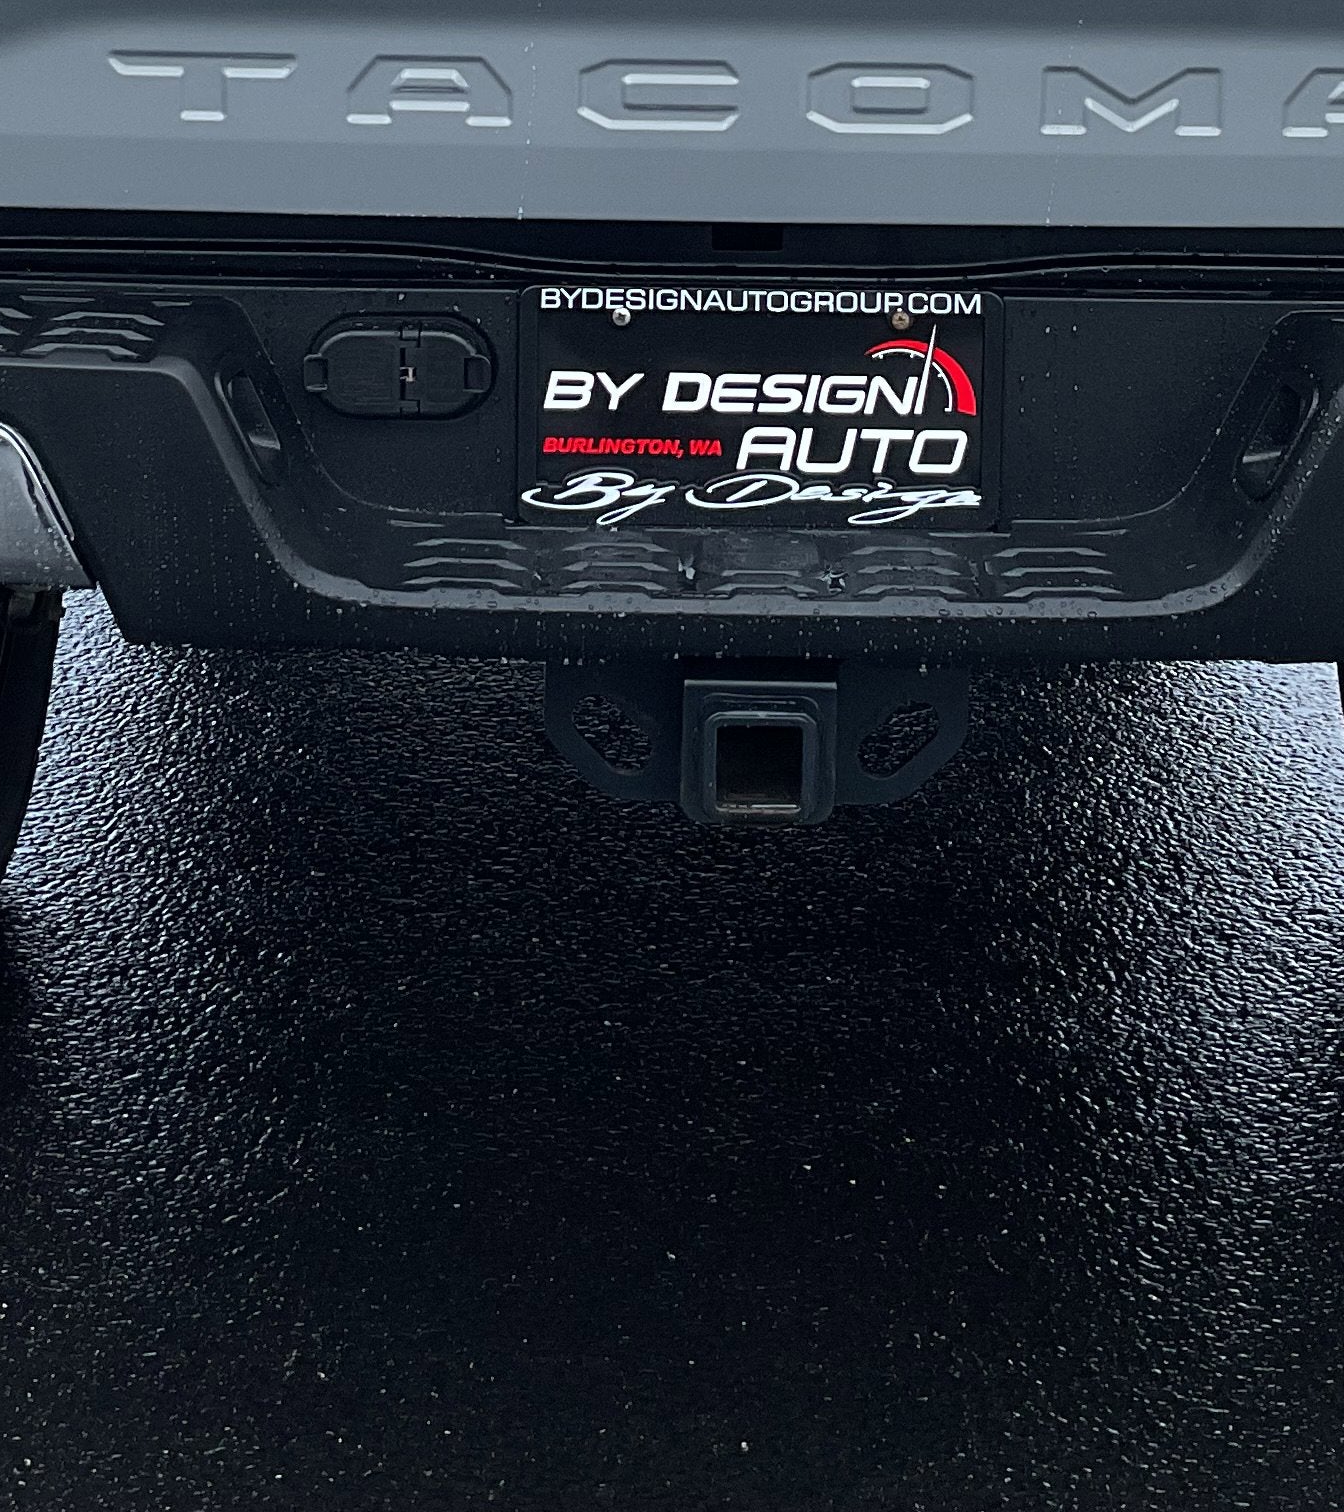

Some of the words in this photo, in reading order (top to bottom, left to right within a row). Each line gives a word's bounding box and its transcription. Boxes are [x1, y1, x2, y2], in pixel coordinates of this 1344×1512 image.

[540, 288, 983, 316] BYDESIGNAUTOGROUP.COM
[543, 370, 645, 412] BY
[661, 372, 920, 416] DESIGN
[542, 437, 685, 458] BURLINGTON,
[689, 439, 723, 457] WA
[736, 426, 969, 475] AUTO
[521, 471, 676, 526] By
[684, 472, 983, 525] Design
